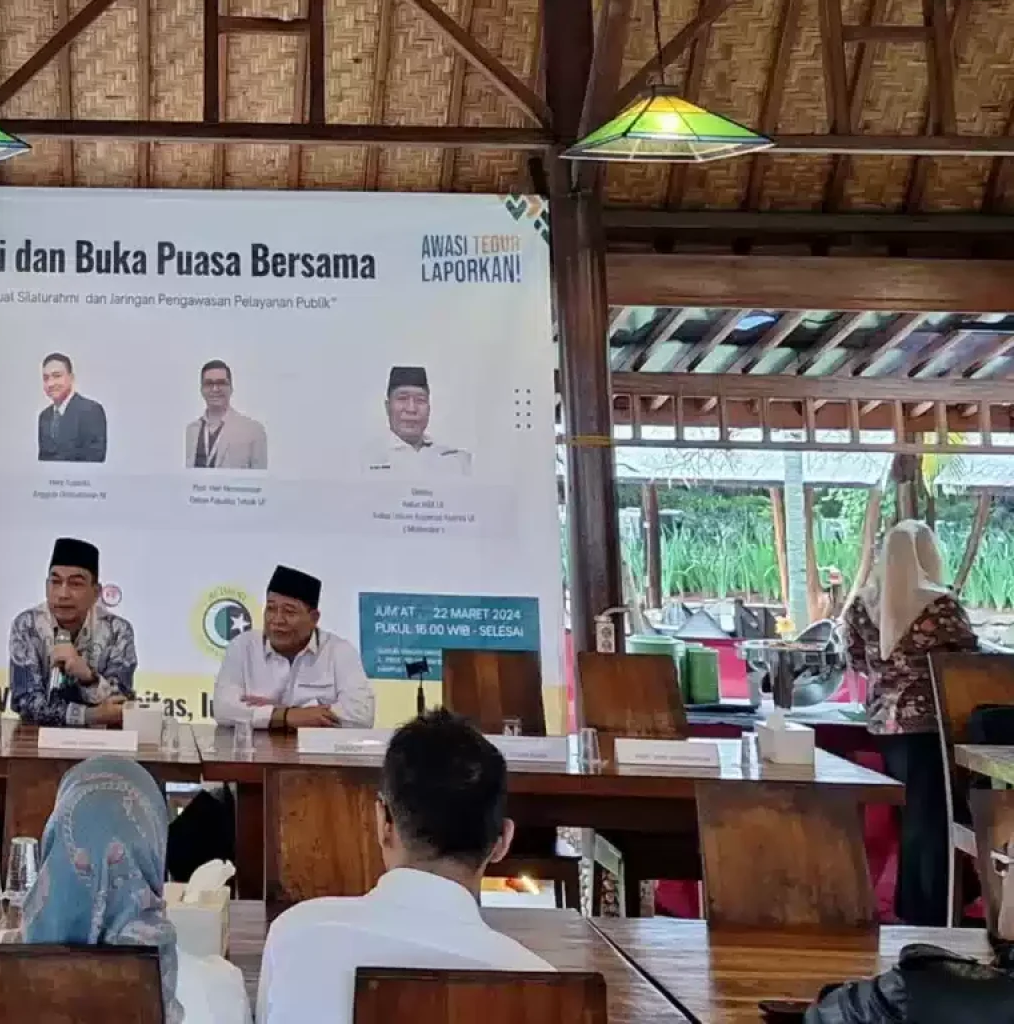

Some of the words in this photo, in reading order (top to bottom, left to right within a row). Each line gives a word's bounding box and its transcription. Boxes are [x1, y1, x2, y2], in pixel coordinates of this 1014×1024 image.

[422, 235, 468, 258] AWASI
[15, 239, 66, 273] dan
[75, 240, 147, 274] Buka
[157, 241, 241, 276] Puasa
[251, 243, 375, 279] Bersama
[421, 254, 521, 283] LAPORKAN!
[85, 293, 106, 305] dan
[109, 293, 155, 308] Jaringan
[158, 293, 230, 309] Pengawasan
[235, 295, 293, 310] Pelayanan
[433, 607, 448, 619] 22
[450, 607, 490, 620] MARET
[492, 608, 522, 621] 2024
[374, 622, 413, 634] PUKUL
[447, 624, 471, 637] WIB
[479, 625, 524, 638] SELESAI
